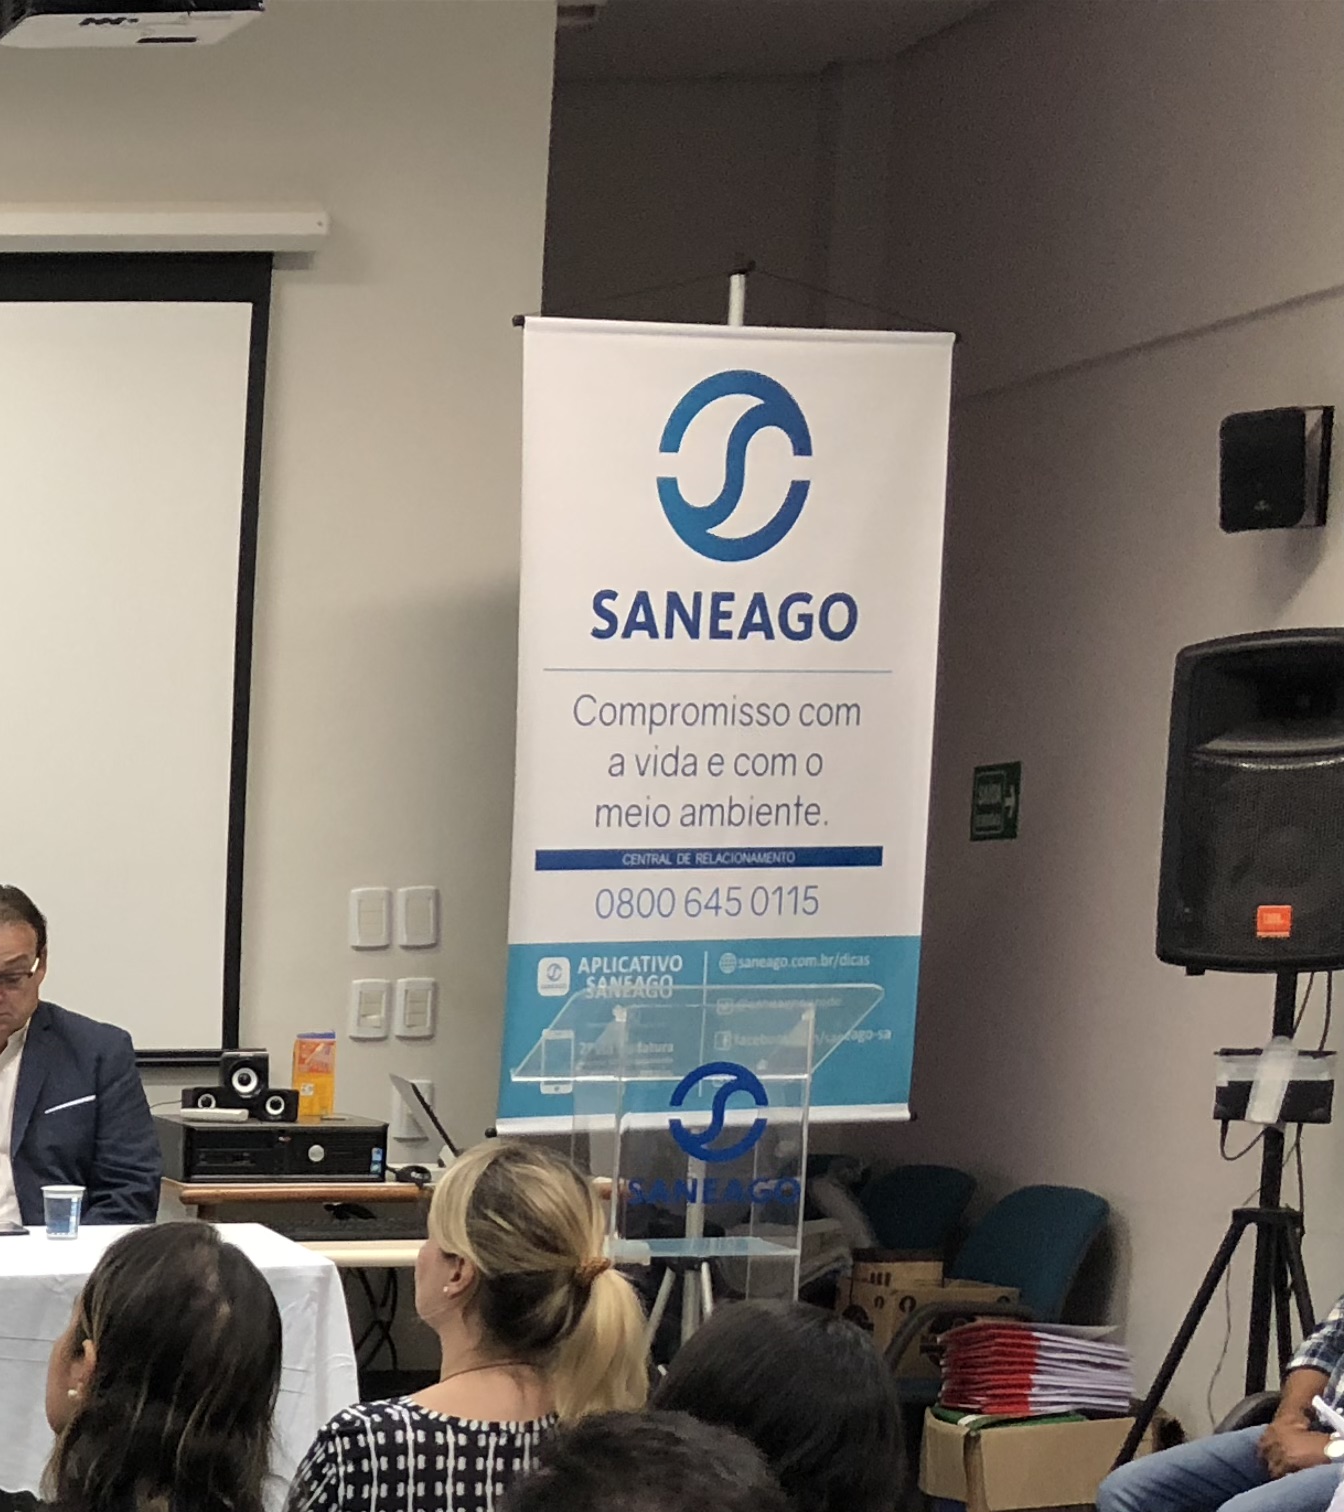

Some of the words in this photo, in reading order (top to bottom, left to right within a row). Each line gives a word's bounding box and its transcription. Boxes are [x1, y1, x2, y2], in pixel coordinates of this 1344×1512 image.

[589, 589, 858, 641] SANEAGO
[572, 693, 790, 735] Compromisso
[798, 700, 862, 727] com
[608, 751, 626, 777] a
[634, 745, 698, 777] vida
[706, 751, 725, 777] e
[733, 750, 797, 777] com
[805, 750, 824, 777] o
[595, 795, 671, 829] meio
[679, 795, 830, 828] ambiente.
[622, 851, 673, 866] CENTRAL
[676, 851, 691, 866] DE
[694, 850, 796, 866] RELACIONAMENTO
[595, 886, 676, 920] 0800
[683, 886, 742, 919] 645
[750, 884, 820, 917] 0115
[577, 955, 683, 974] APLICATIVO
[738, 952, 870, 971] saneago.com.br/dicas
[585, 974, 674, 999] SANEAGO
[627, 1176, 802, 1206] SANEAGO
